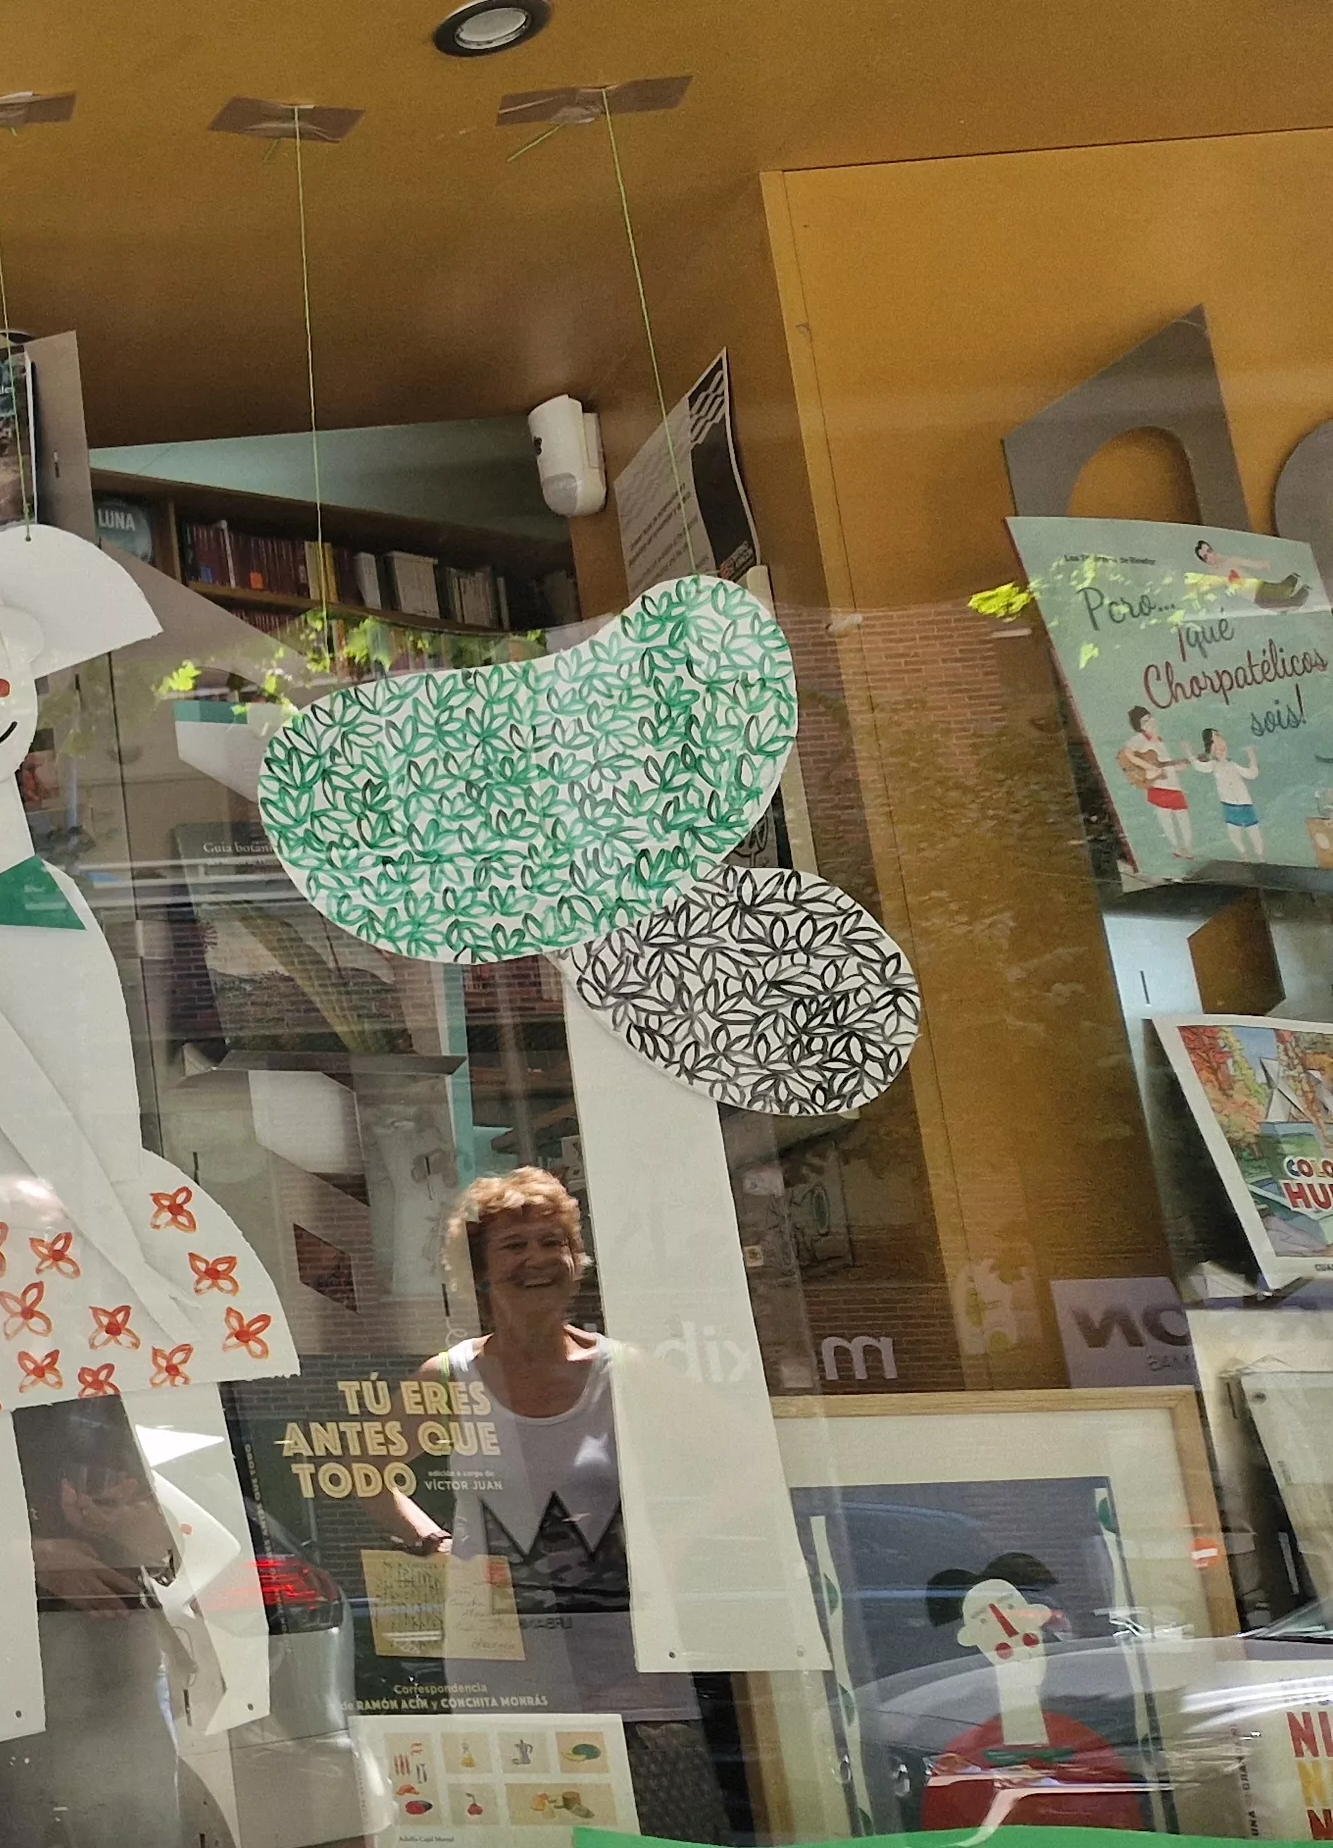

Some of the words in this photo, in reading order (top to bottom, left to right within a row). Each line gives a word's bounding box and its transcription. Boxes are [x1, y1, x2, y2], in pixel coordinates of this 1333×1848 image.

[97, 508, 136, 532] LUNA
[1144, 638, 1328, 709] Chorpatélicos
[1250, 683, 1307, 737] sois!
[1283, 1182, 1333, 1210] HU
[337, 1371, 392, 1416] TÚ
[400, 1380, 493, 1416] ERES
[282, 1420, 409, 1457] ANTES
[417, 1421, 501, 1457] QUE
[291, 1461, 417, 1499] TODO
[424, 1478, 468, 1491] VÍCTOR
[471, 1480, 504, 1491] JUAN
[356, 1697, 398, 1710] RAMÓN
[400, 1696, 429, 1710] ACÍN
[432, 1701, 438, 1711] y
[440, 1697, 498, 1709] CONCHITA
[500, 1696, 548, 1708] MONRÁS
[393, 1683, 488, 1697] Correspondencia
